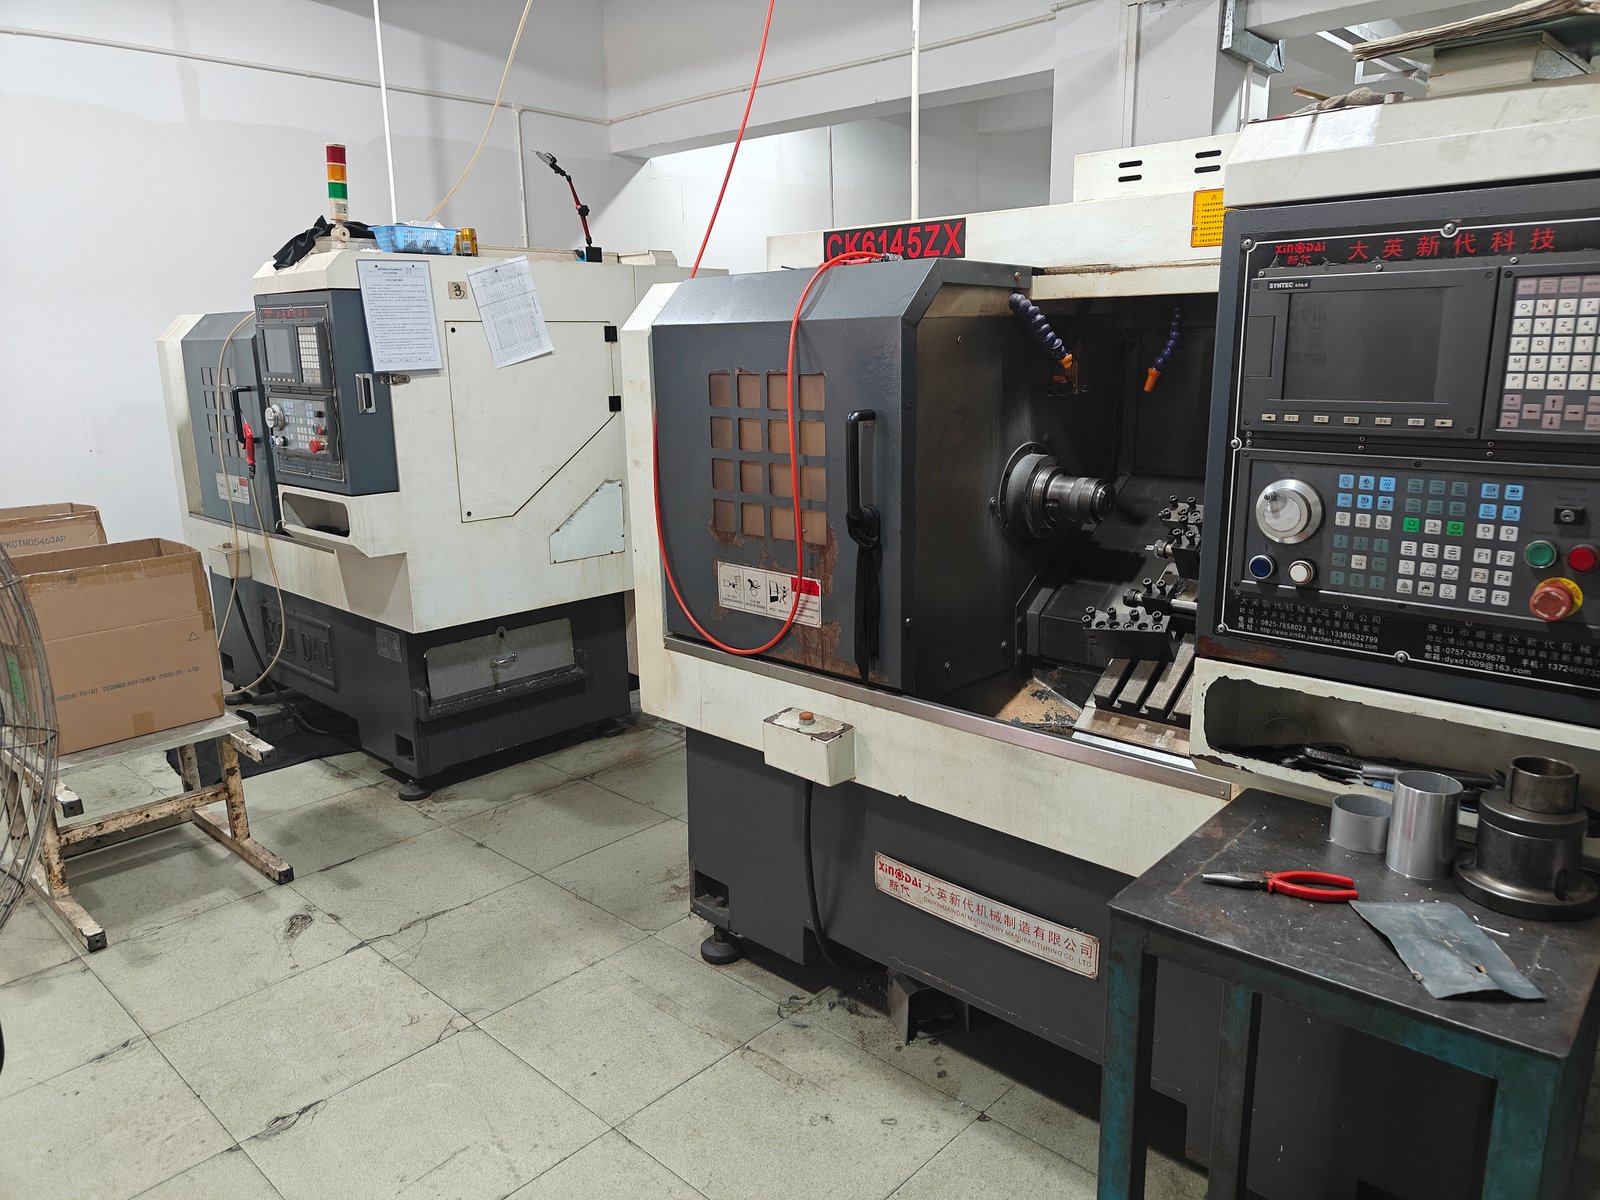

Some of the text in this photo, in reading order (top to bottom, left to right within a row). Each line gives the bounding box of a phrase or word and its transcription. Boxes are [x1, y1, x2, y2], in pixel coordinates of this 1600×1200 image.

[826, 222, 963, 260] CK6145ZX
[1348, 228, 1556, 260] 大英新代科技
[1477, 552, 1489, 560] F1
[1500, 554, 1512, 563] F2
[1474, 571, 1486, 579] F3
[1498, 574, 1509, 582] F4
[1495, 594, 1507, 602] F5
[1331, 630, 1379, 643] 13380522799
[890, 879, 910, 897] 新代
[924, 882, 1093, 959] 大英新代机械制造有限公司
[967, 915, 1004, 933] MACHINERY
[1004, 930, 1063, 957] MANUFACTURING
